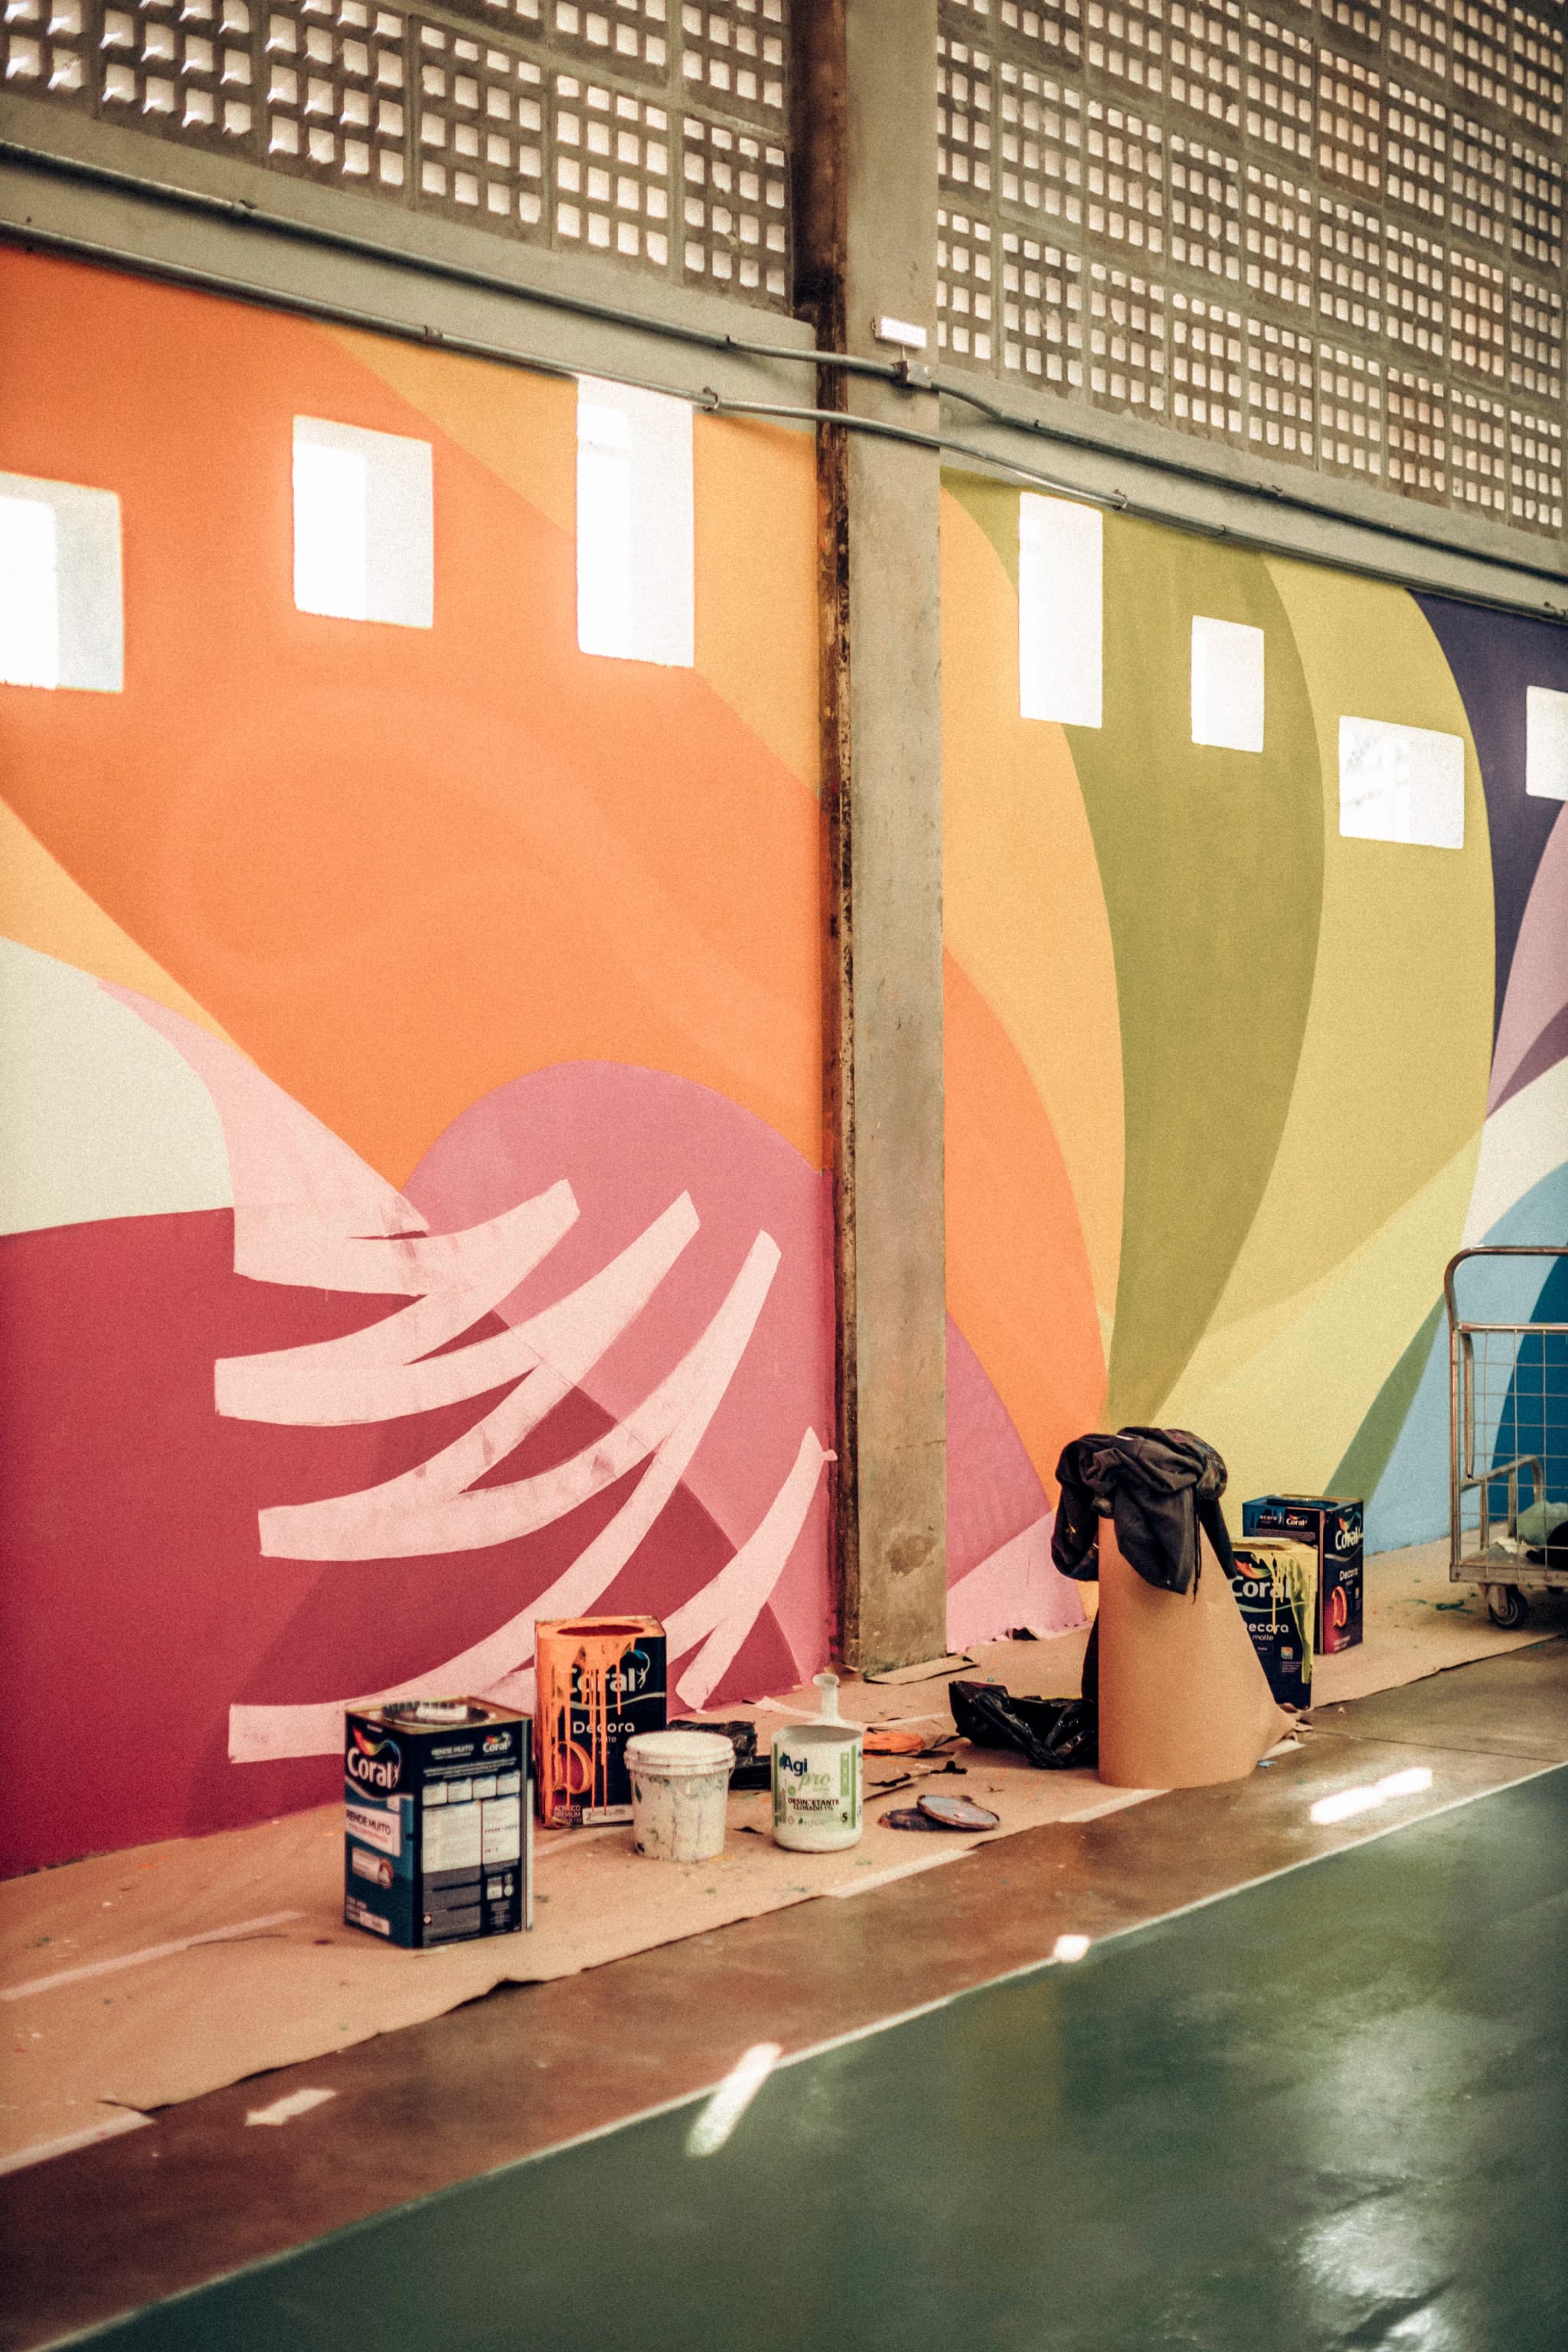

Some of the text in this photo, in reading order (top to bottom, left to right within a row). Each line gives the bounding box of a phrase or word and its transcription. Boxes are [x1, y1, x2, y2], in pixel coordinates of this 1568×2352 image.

[1340, 1568, 1358, 1581] Decora
[1245, 1623, 1289, 1633] ecora
[453, 1744, 474, 1753] MUITO
[482, 1742, 508, 1753] Coral
[347, 1746, 393, 1789] Coral
[782, 1754, 808, 1776] Agi
[798, 1772, 831, 1792] pro
[346, 1809, 368, 1827] RENDE
[368, 1819, 391, 1835] MUITO
